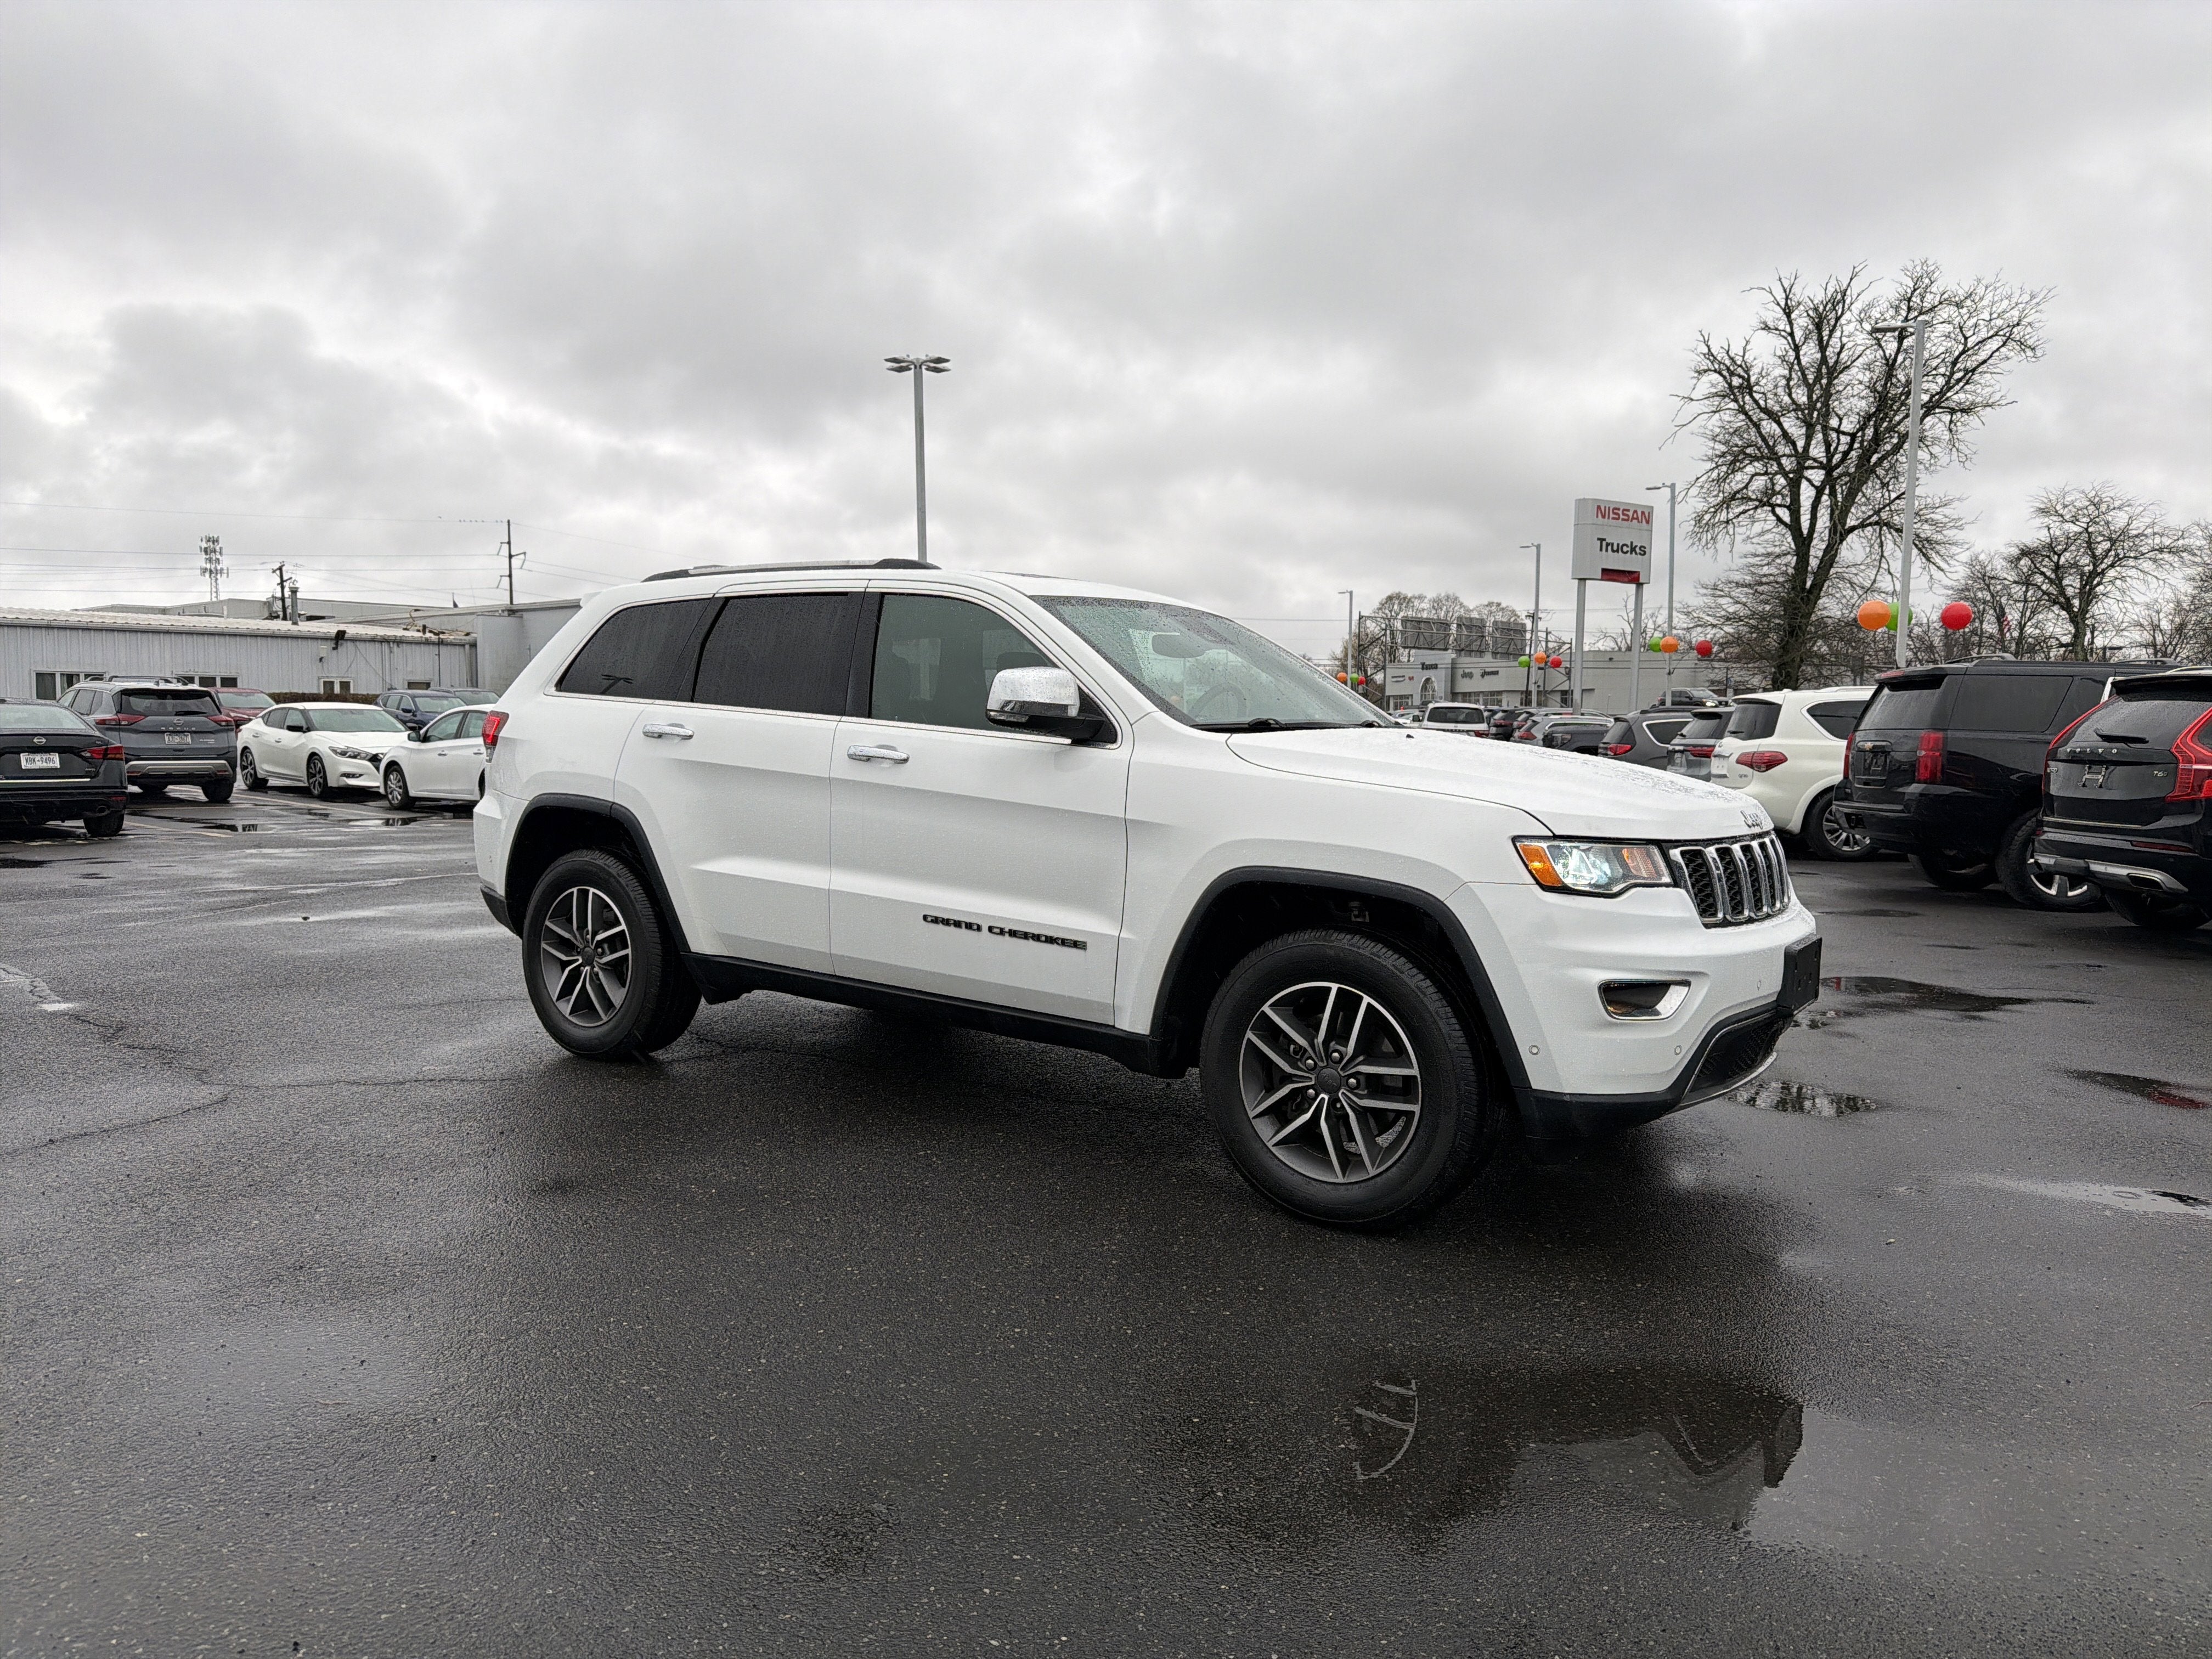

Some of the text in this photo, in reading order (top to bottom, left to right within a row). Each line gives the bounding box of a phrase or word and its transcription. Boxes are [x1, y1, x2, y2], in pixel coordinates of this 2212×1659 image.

[1596, 505, 1650, 525] NISSAN
[1596, 537, 1646, 556] Trucks
[1740, 810, 1763, 830] Jeep
[922, 914, 1087, 951] GRAND CHEROKEE
